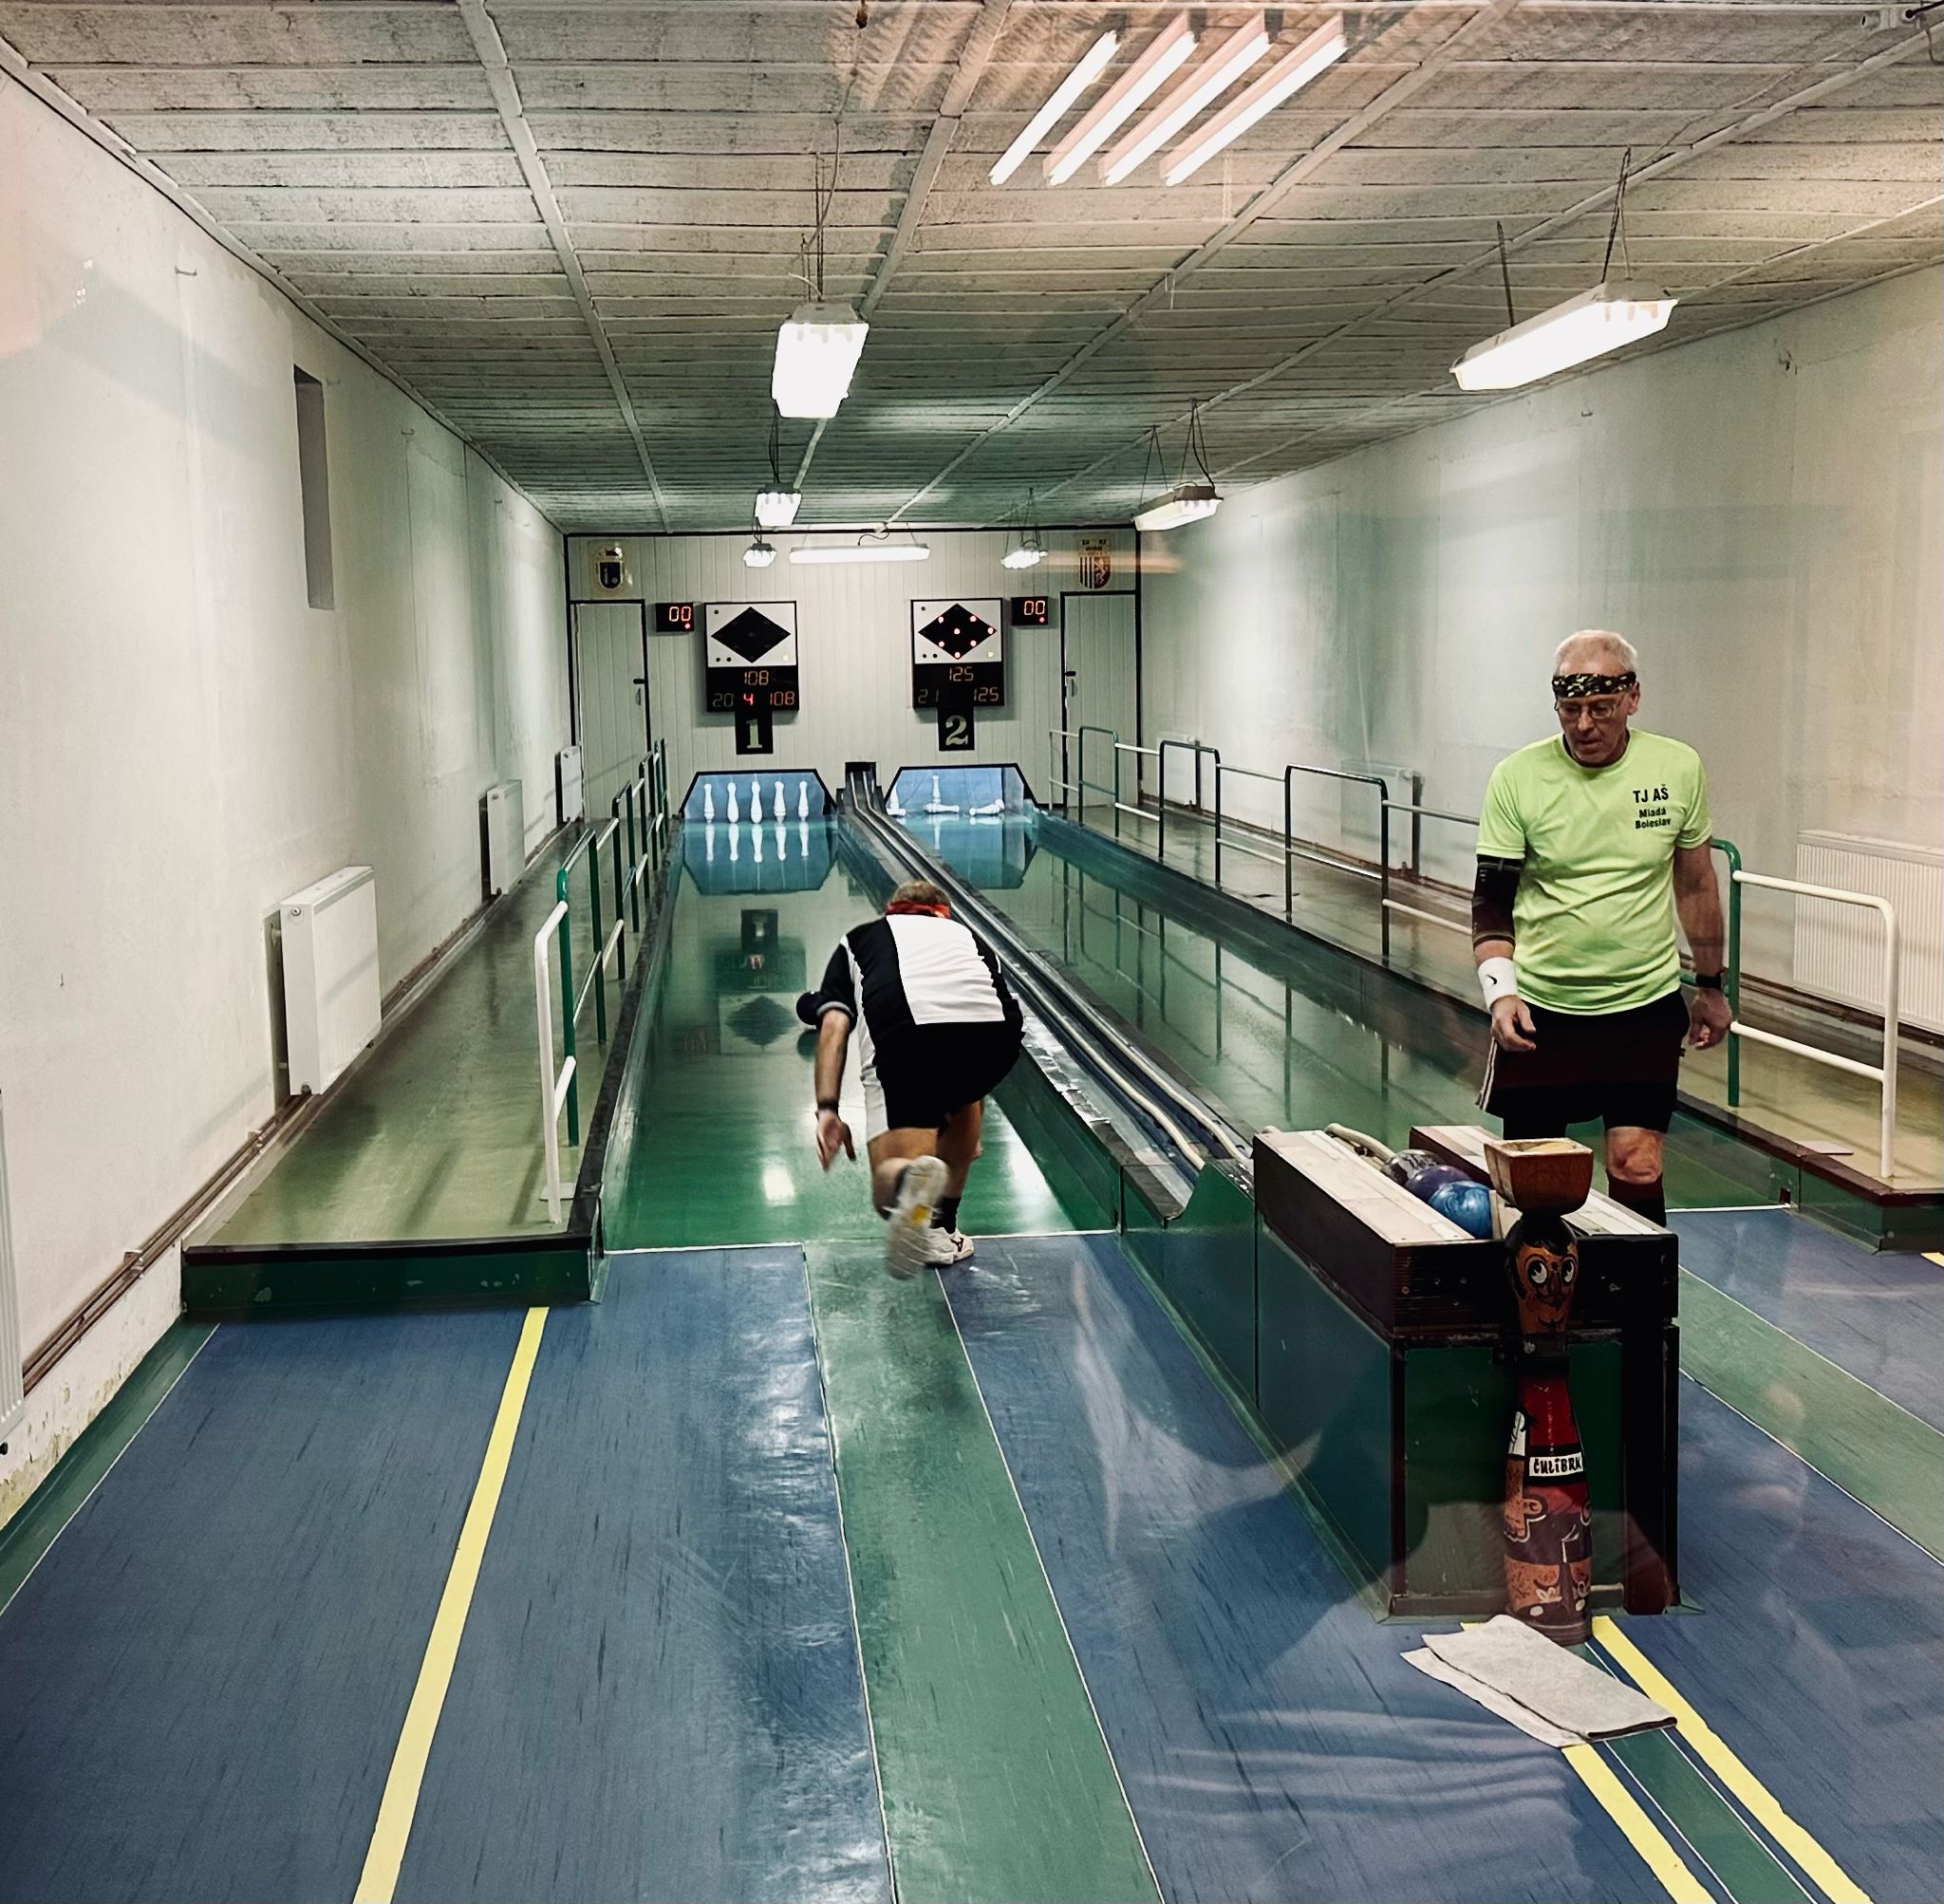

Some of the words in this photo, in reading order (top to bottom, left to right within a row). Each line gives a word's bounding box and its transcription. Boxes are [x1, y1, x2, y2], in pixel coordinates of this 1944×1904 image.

[668, 606, 691, 622] 00
[1023, 600, 1045, 615] 00
[744, 670, 769, 685] 108
[949, 666, 974, 682] 125
[743, 692, 754, 706] 4
[770, 691, 795, 706] 108
[974, 687, 1000, 702] 125
[746, 719, 763, 749] 1
[945, 715, 969, 746] 2
[1633, 790, 1648, 803] TJ
[1653, 784, 1669, 801] AŠ
[1636, 818, 1671, 829] Boleslav
